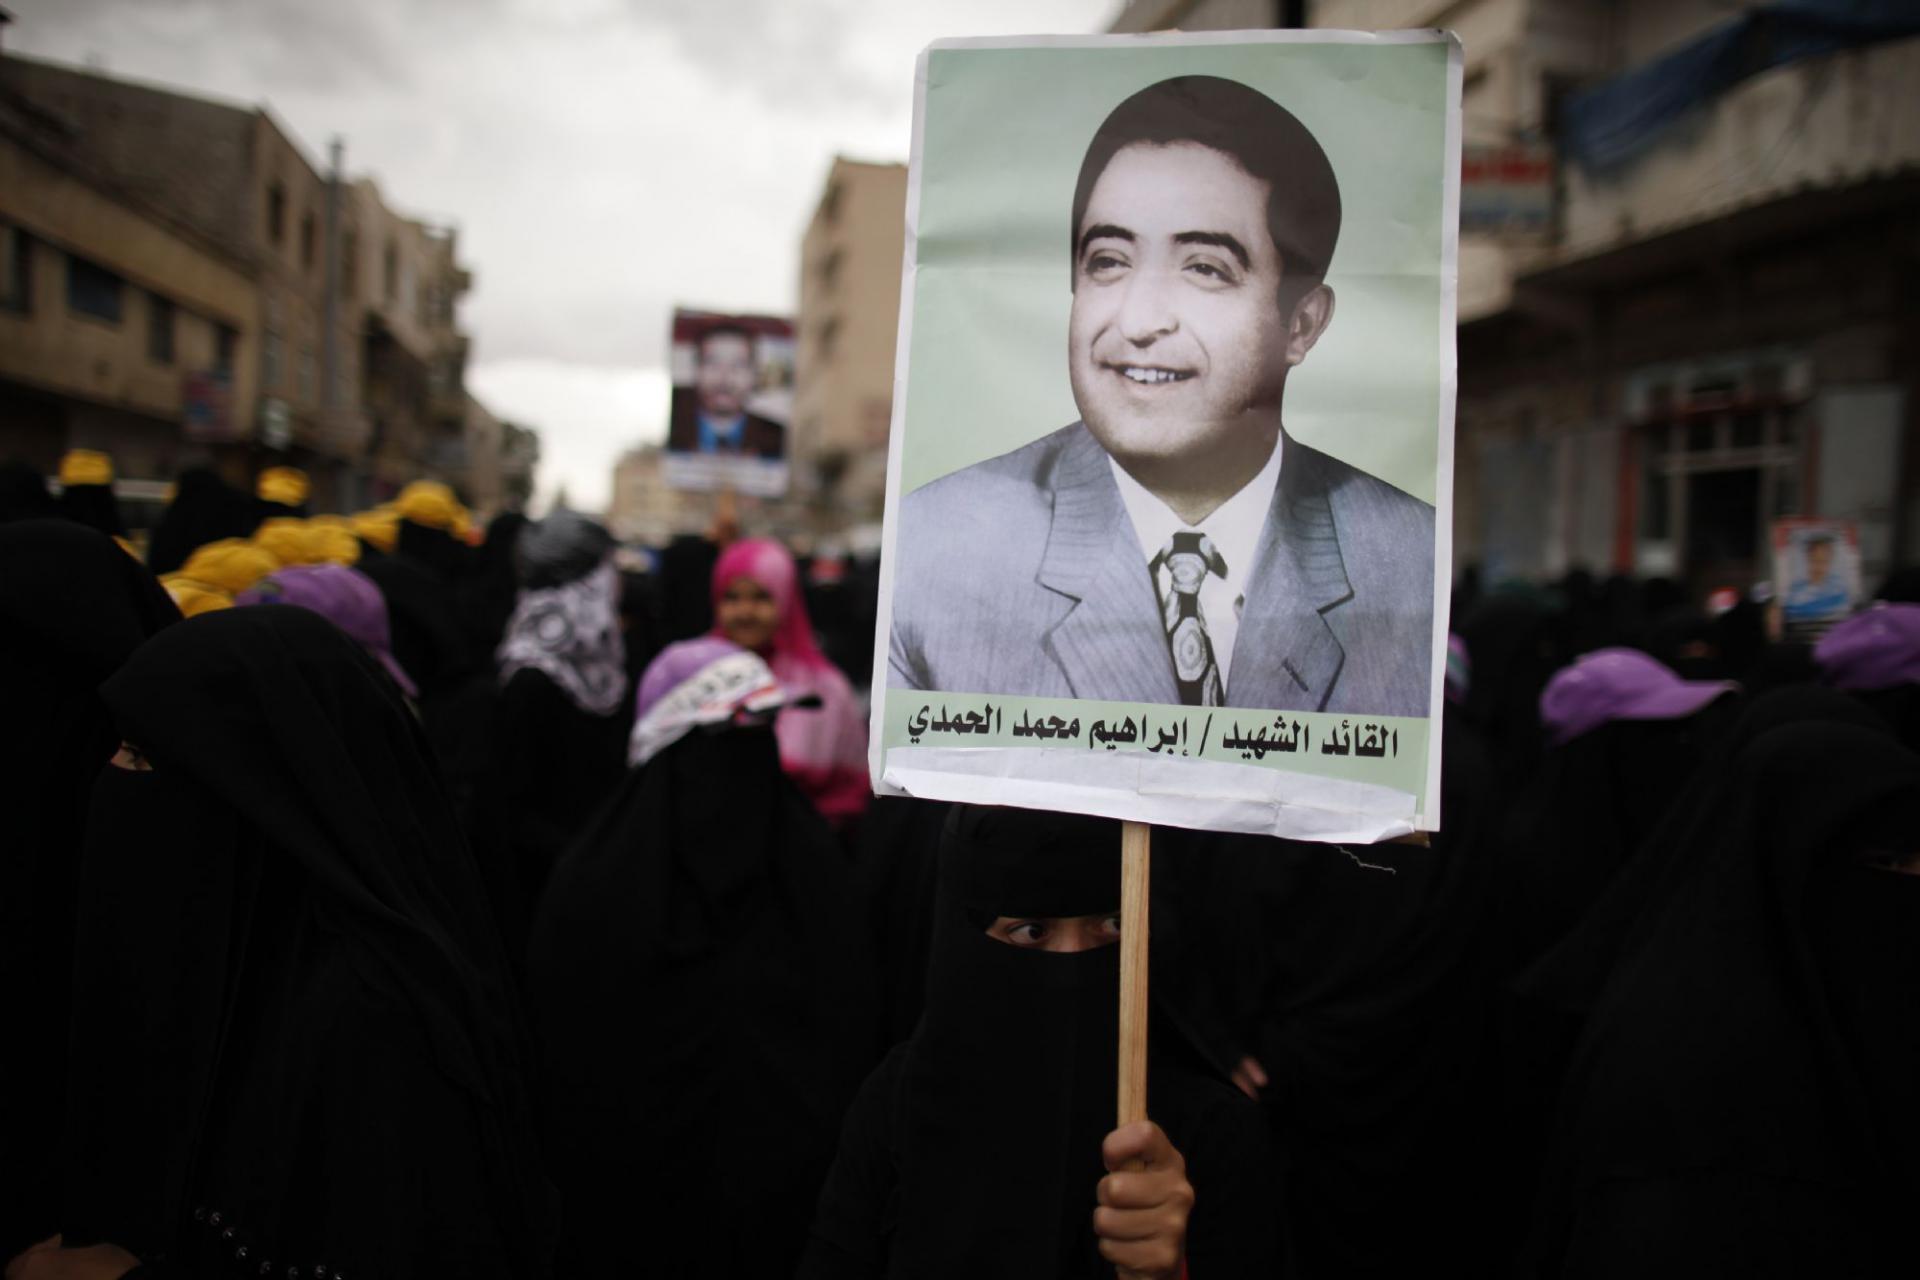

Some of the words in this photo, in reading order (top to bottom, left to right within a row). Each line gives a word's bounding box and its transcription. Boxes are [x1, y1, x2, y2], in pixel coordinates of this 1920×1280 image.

[907, 703, 1002, 744] الحمدي
[1012, 709, 1081, 740] محمد
[1089, 713, 1188, 757] إبراهيم
[1198, 713, 1213, 757] /
[1222, 715, 1310, 760] الشهيد
[1321, 719, 1398, 758] القائد
